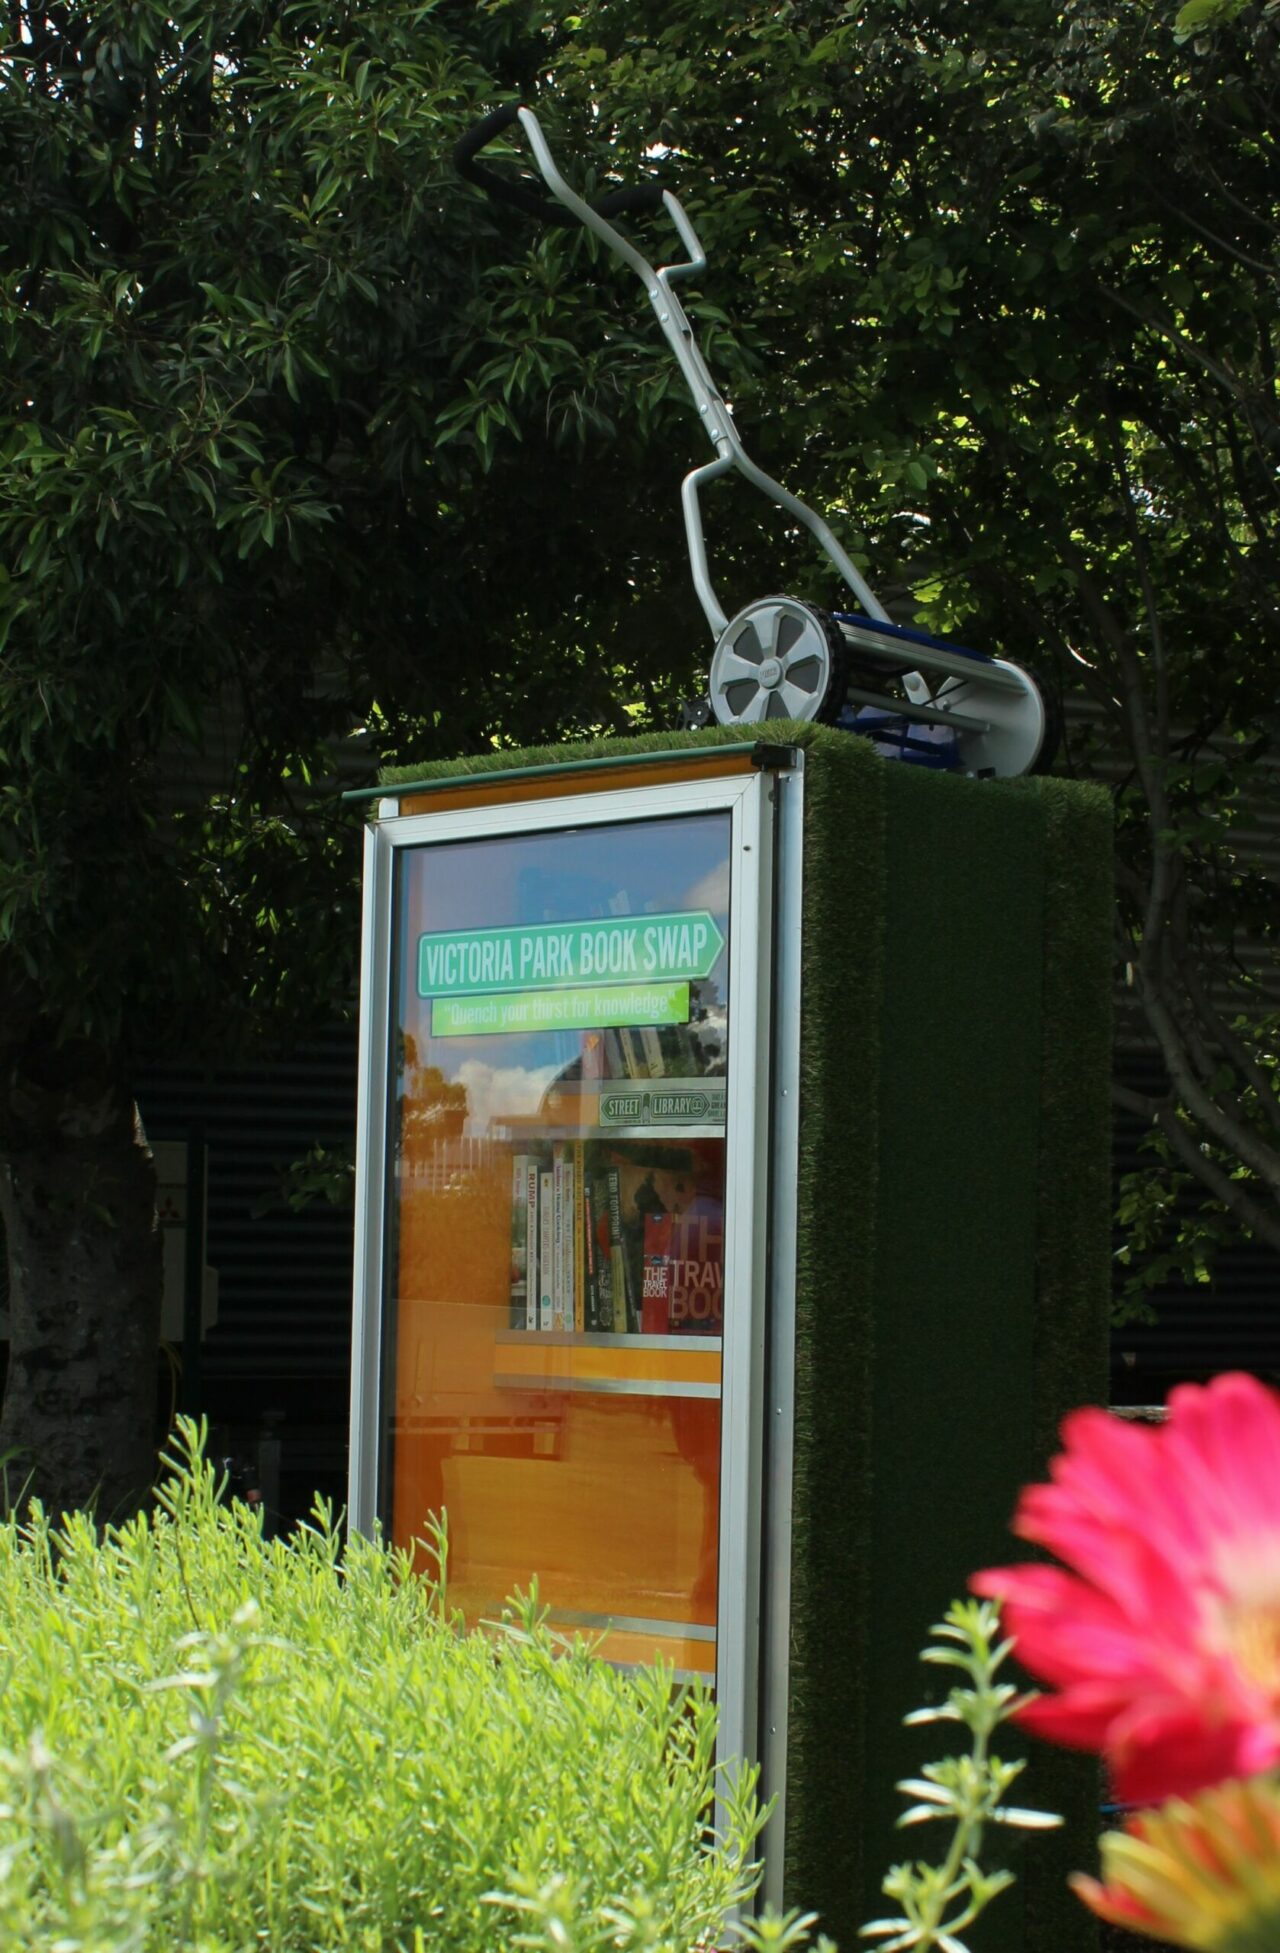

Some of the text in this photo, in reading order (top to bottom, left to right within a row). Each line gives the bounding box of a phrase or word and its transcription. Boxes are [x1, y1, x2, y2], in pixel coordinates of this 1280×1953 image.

[426, 923, 708, 986] VICTORIA PARK BOOK SWAP
[501, 1003, 529, 1027] your
[532, 998, 569, 1021] thirst
[572, 995, 591, 1018] for
[608, 1099, 640, 1116] STREET
[654, 1097, 692, 1114] LIBRARY
[528, 1173, 536, 1209] RUMP
[608, 1172, 620, 1239] ZERO FOOTPRINT
[643, 1280, 667, 1289] TRAVEL
[644, 1266, 668, 1281] THE
[642, 1288, 668, 1298] BOOK
